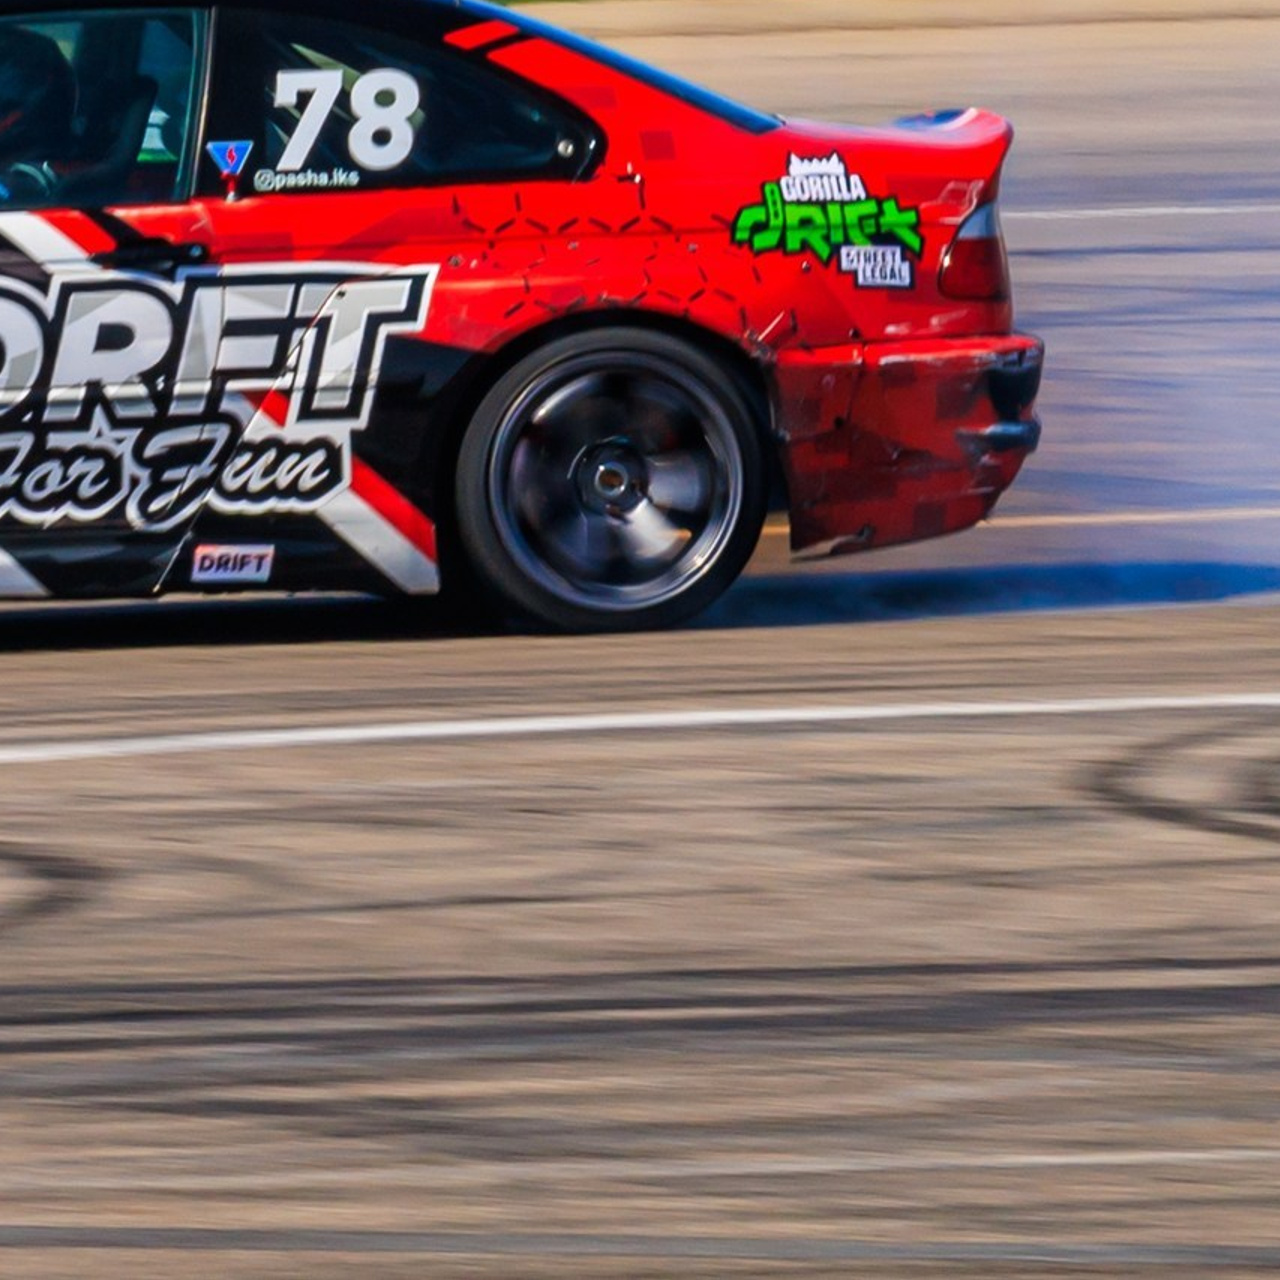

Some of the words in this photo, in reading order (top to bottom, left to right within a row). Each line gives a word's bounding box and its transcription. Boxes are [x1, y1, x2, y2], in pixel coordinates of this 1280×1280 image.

[274, 68, 420, 170] 78
[780, 174, 867, 201] GORILLA
[860, 265, 909, 284] LEGAL
[130, 420, 335, 520] Fun
[198, 553, 269, 573] DRIFT
